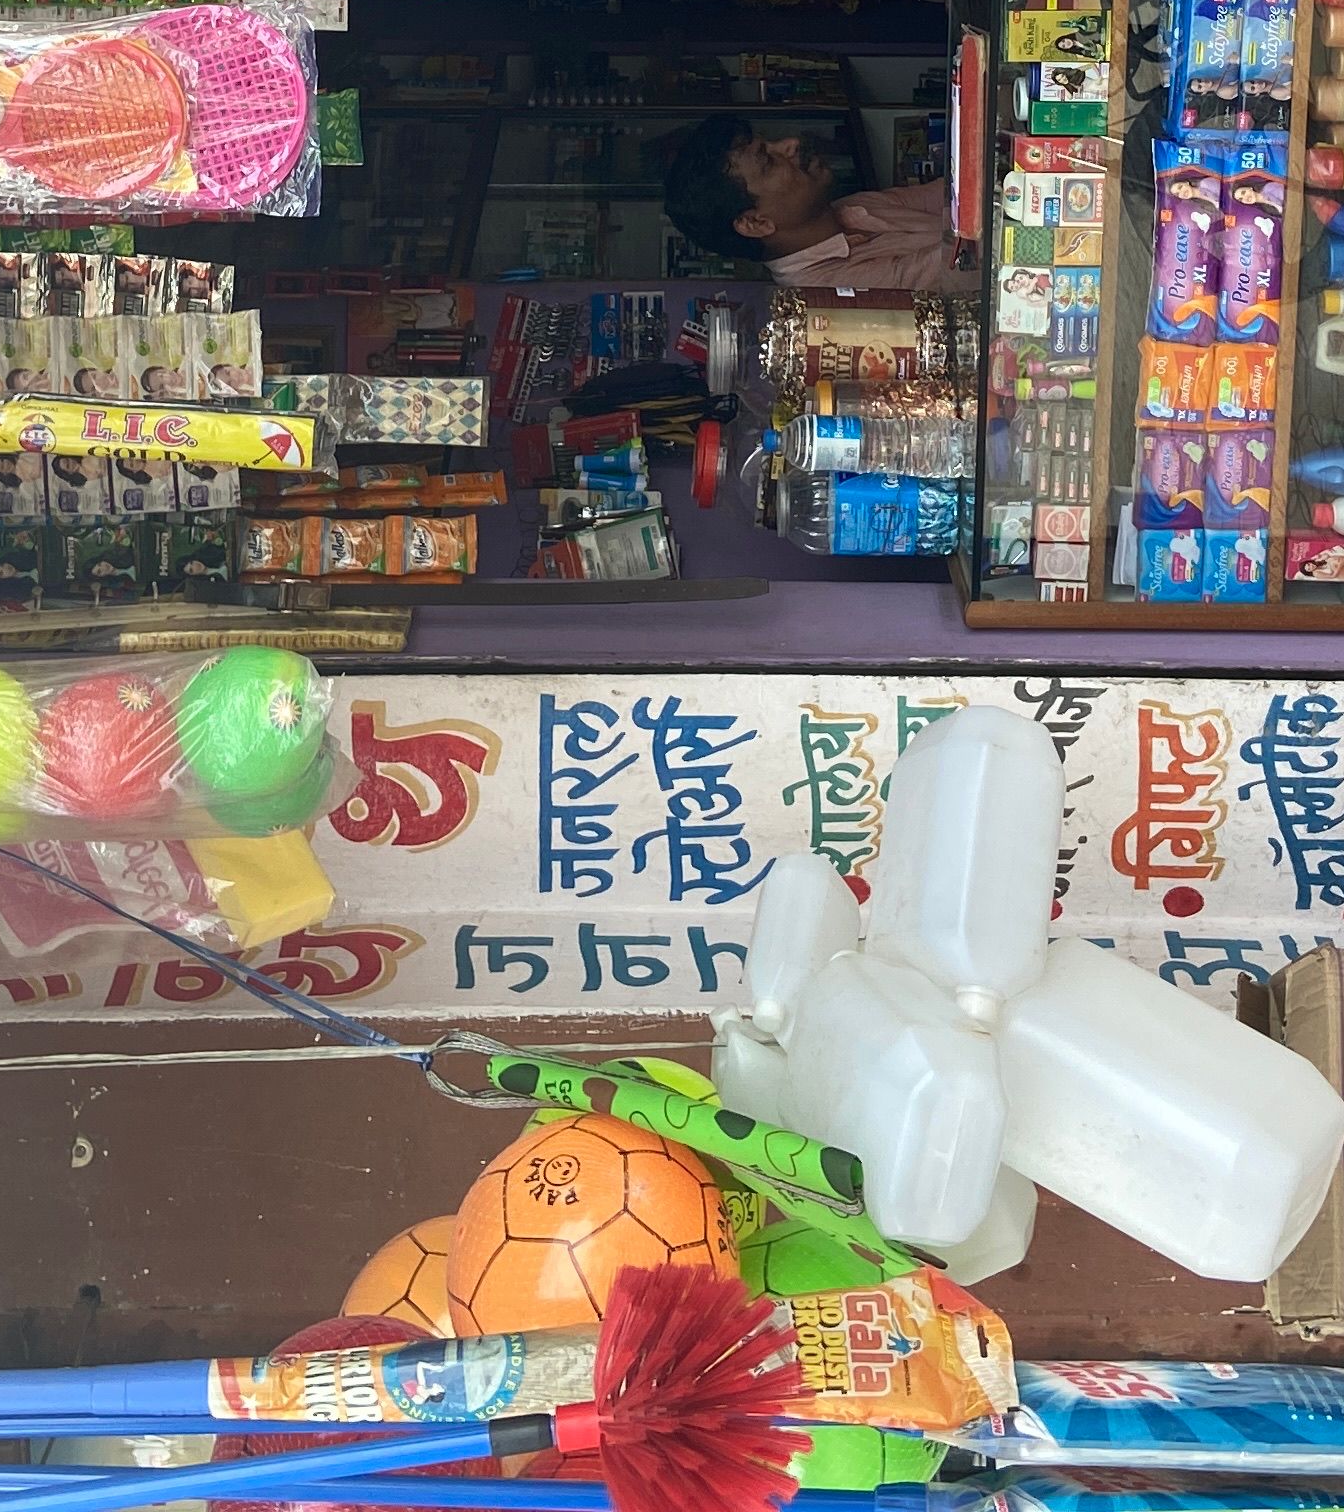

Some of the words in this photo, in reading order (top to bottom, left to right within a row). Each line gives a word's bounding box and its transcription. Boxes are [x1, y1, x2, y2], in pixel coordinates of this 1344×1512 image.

[1207, 5, 1229, 68] Stayfree
[1260, 6, 1282, 69] Stayfree
[1178, 147, 1192, 164] 50
[1242, 152, 1256, 169] 50
[1168, 224, 1190, 299] Pro-ease
[1193, 265, 1207, 283] XL
[1232, 229, 1253, 304] Pro-ease
[1257, 269, 1270, 287] XL
[819, 337, 837, 380] OFFY
[1157, 443, 1171, 494] Pro-ease
[1220, 442, 1234, 492] Pro-ease
[1148, 545, 1164, 592] Stayfree
[1213, 545, 1229, 592] Stayfree
[538, 693, 639, 898] जनरल
[631, 696, 776, 905] स्टोअर्स
[1111, 706, 1224, 890] गिफ्ट
[817, 1294, 845, 1329] NO
[503, 1335, 523, 1390] ANDLE
[824, 1331, 849, 1392] DUST
[844, 1291, 894, 1396] Gala
